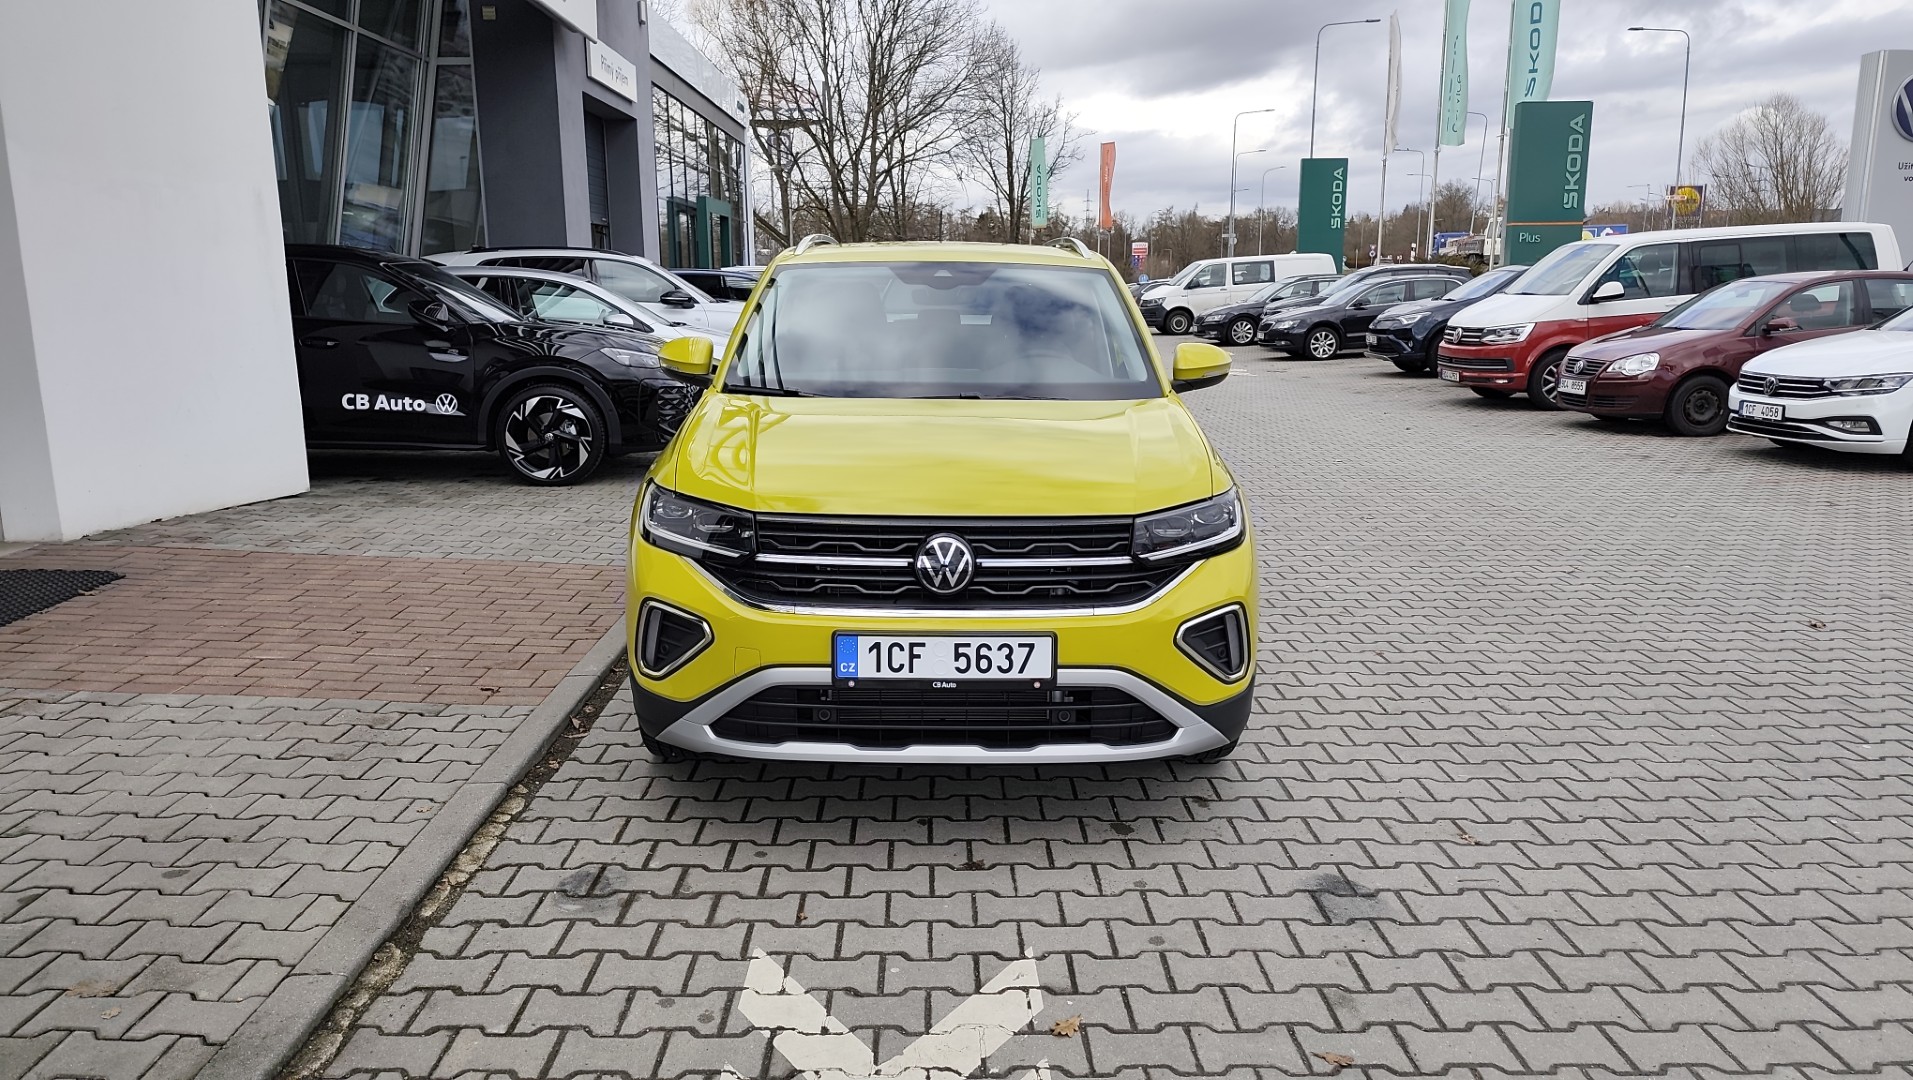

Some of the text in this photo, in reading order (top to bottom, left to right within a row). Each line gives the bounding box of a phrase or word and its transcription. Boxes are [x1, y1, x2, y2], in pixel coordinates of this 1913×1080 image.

[1519, 232, 1541, 243] Plus
[341, 393, 370, 410] CB
[374, 394, 426, 411] Auto
[1745, 404, 1780, 418] 1CF 4058
[840, 641, 1036, 674] CZ 1CF 5637
